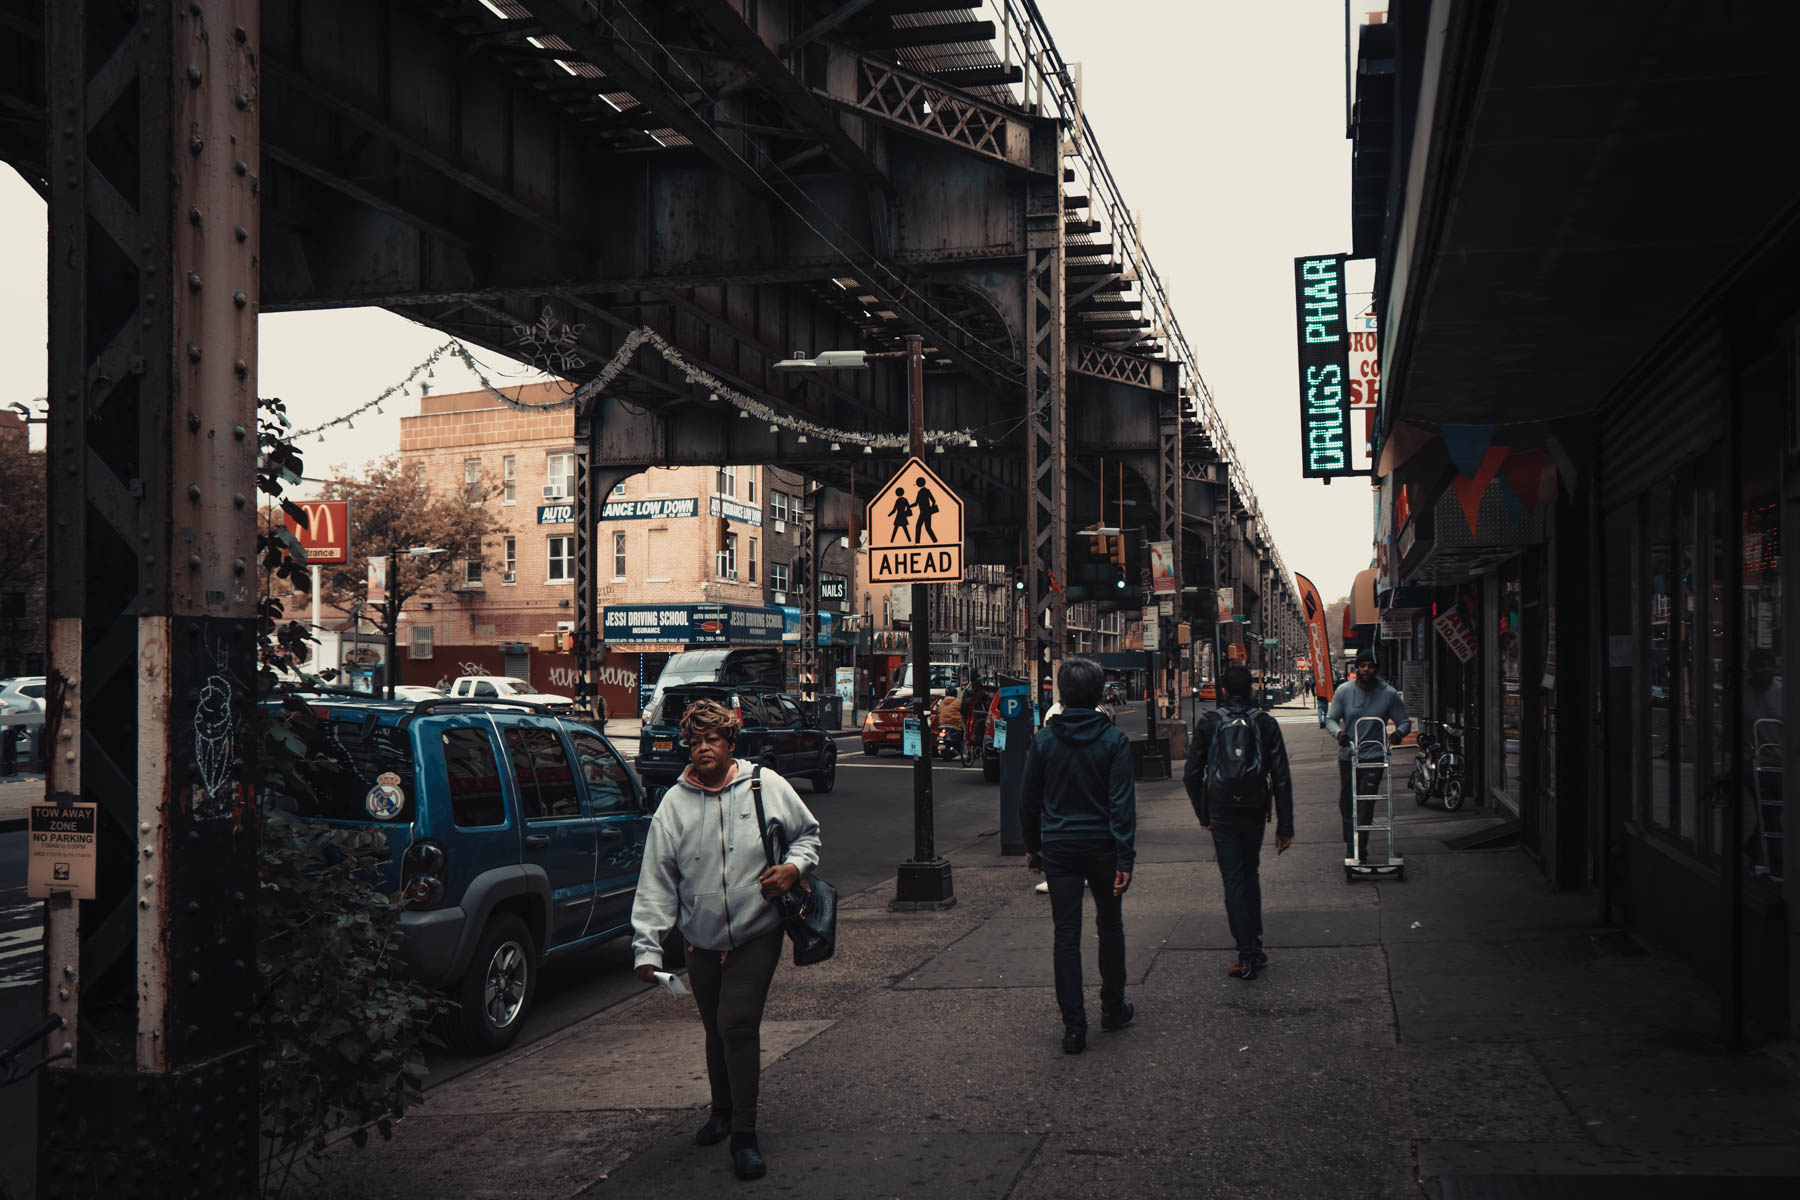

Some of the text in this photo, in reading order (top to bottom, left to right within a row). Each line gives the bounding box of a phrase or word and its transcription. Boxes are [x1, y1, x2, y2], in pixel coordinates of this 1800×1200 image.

[1303, 258, 1344, 470] DRUGS PHAR
[541, 507, 571, 520] AUTO
[636, 501, 661, 516] LOW
[663, 500, 694, 514] DOWN
[879, 552, 952, 575] AHEAD
[822, 584, 843, 598] NAILS
[605, 611, 689, 627] JESSI DRIVING SCHOOL
[1007, 699, 1019, 715] P
[34, 808, 91, 820] TOW AWAY
[49, 821, 77, 831] ZONE
[33, 833, 93, 843] NO PARKING
